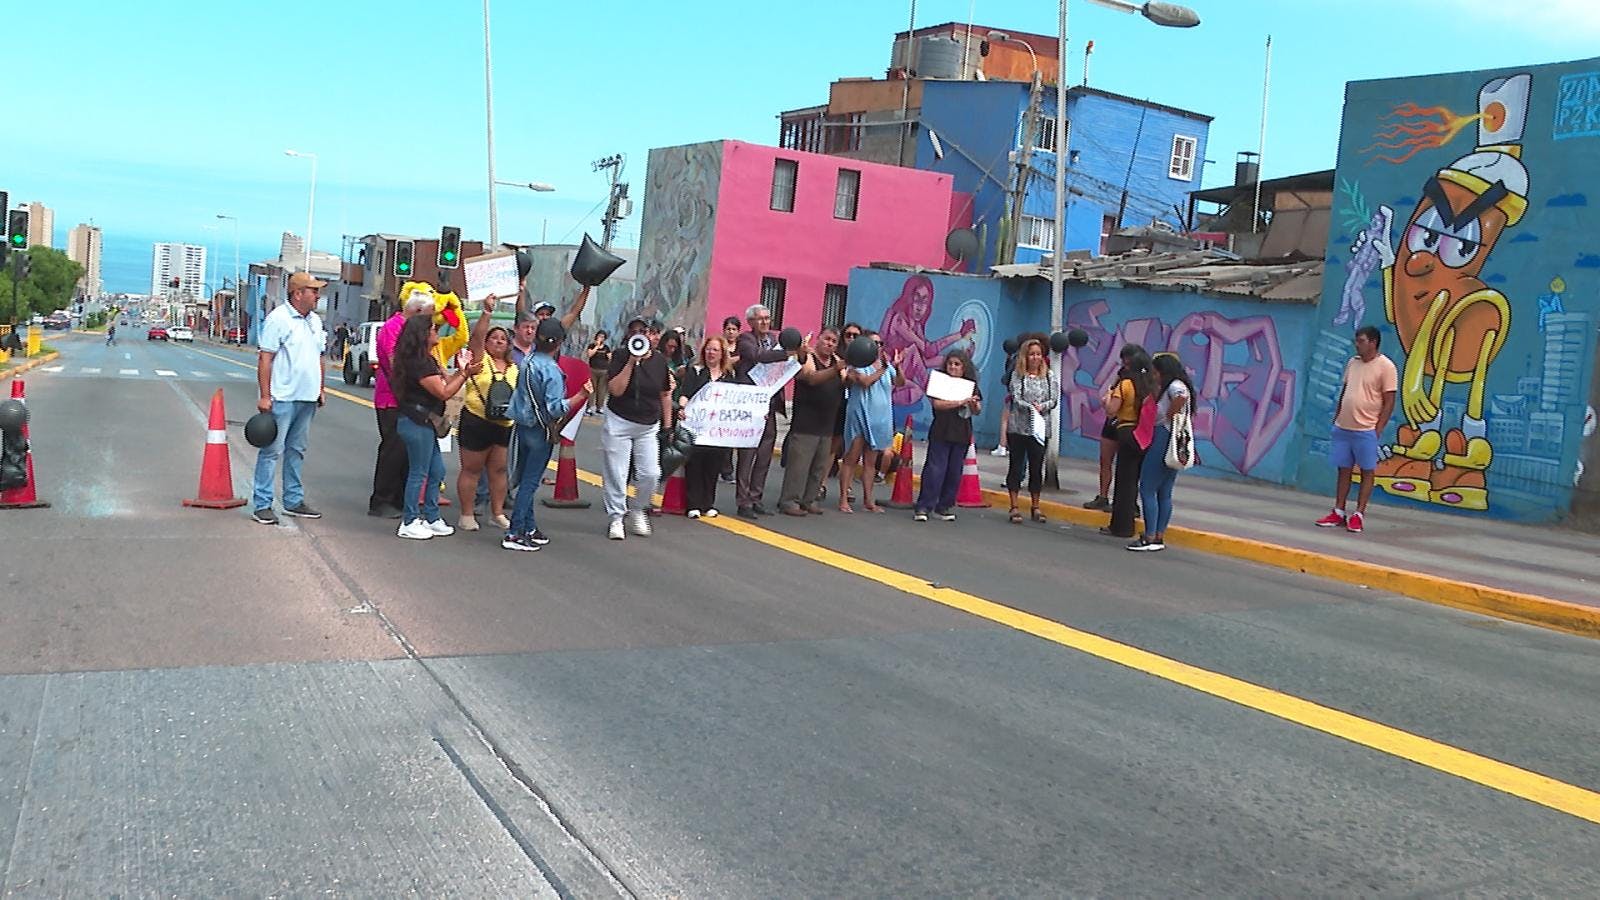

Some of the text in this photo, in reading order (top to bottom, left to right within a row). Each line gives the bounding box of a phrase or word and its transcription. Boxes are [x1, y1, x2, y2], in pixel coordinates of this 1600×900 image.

[691, 408, 707, 422] NO
[719, 408, 752, 422] BAJADA
[708, 427, 754, 438] CAMIONES
